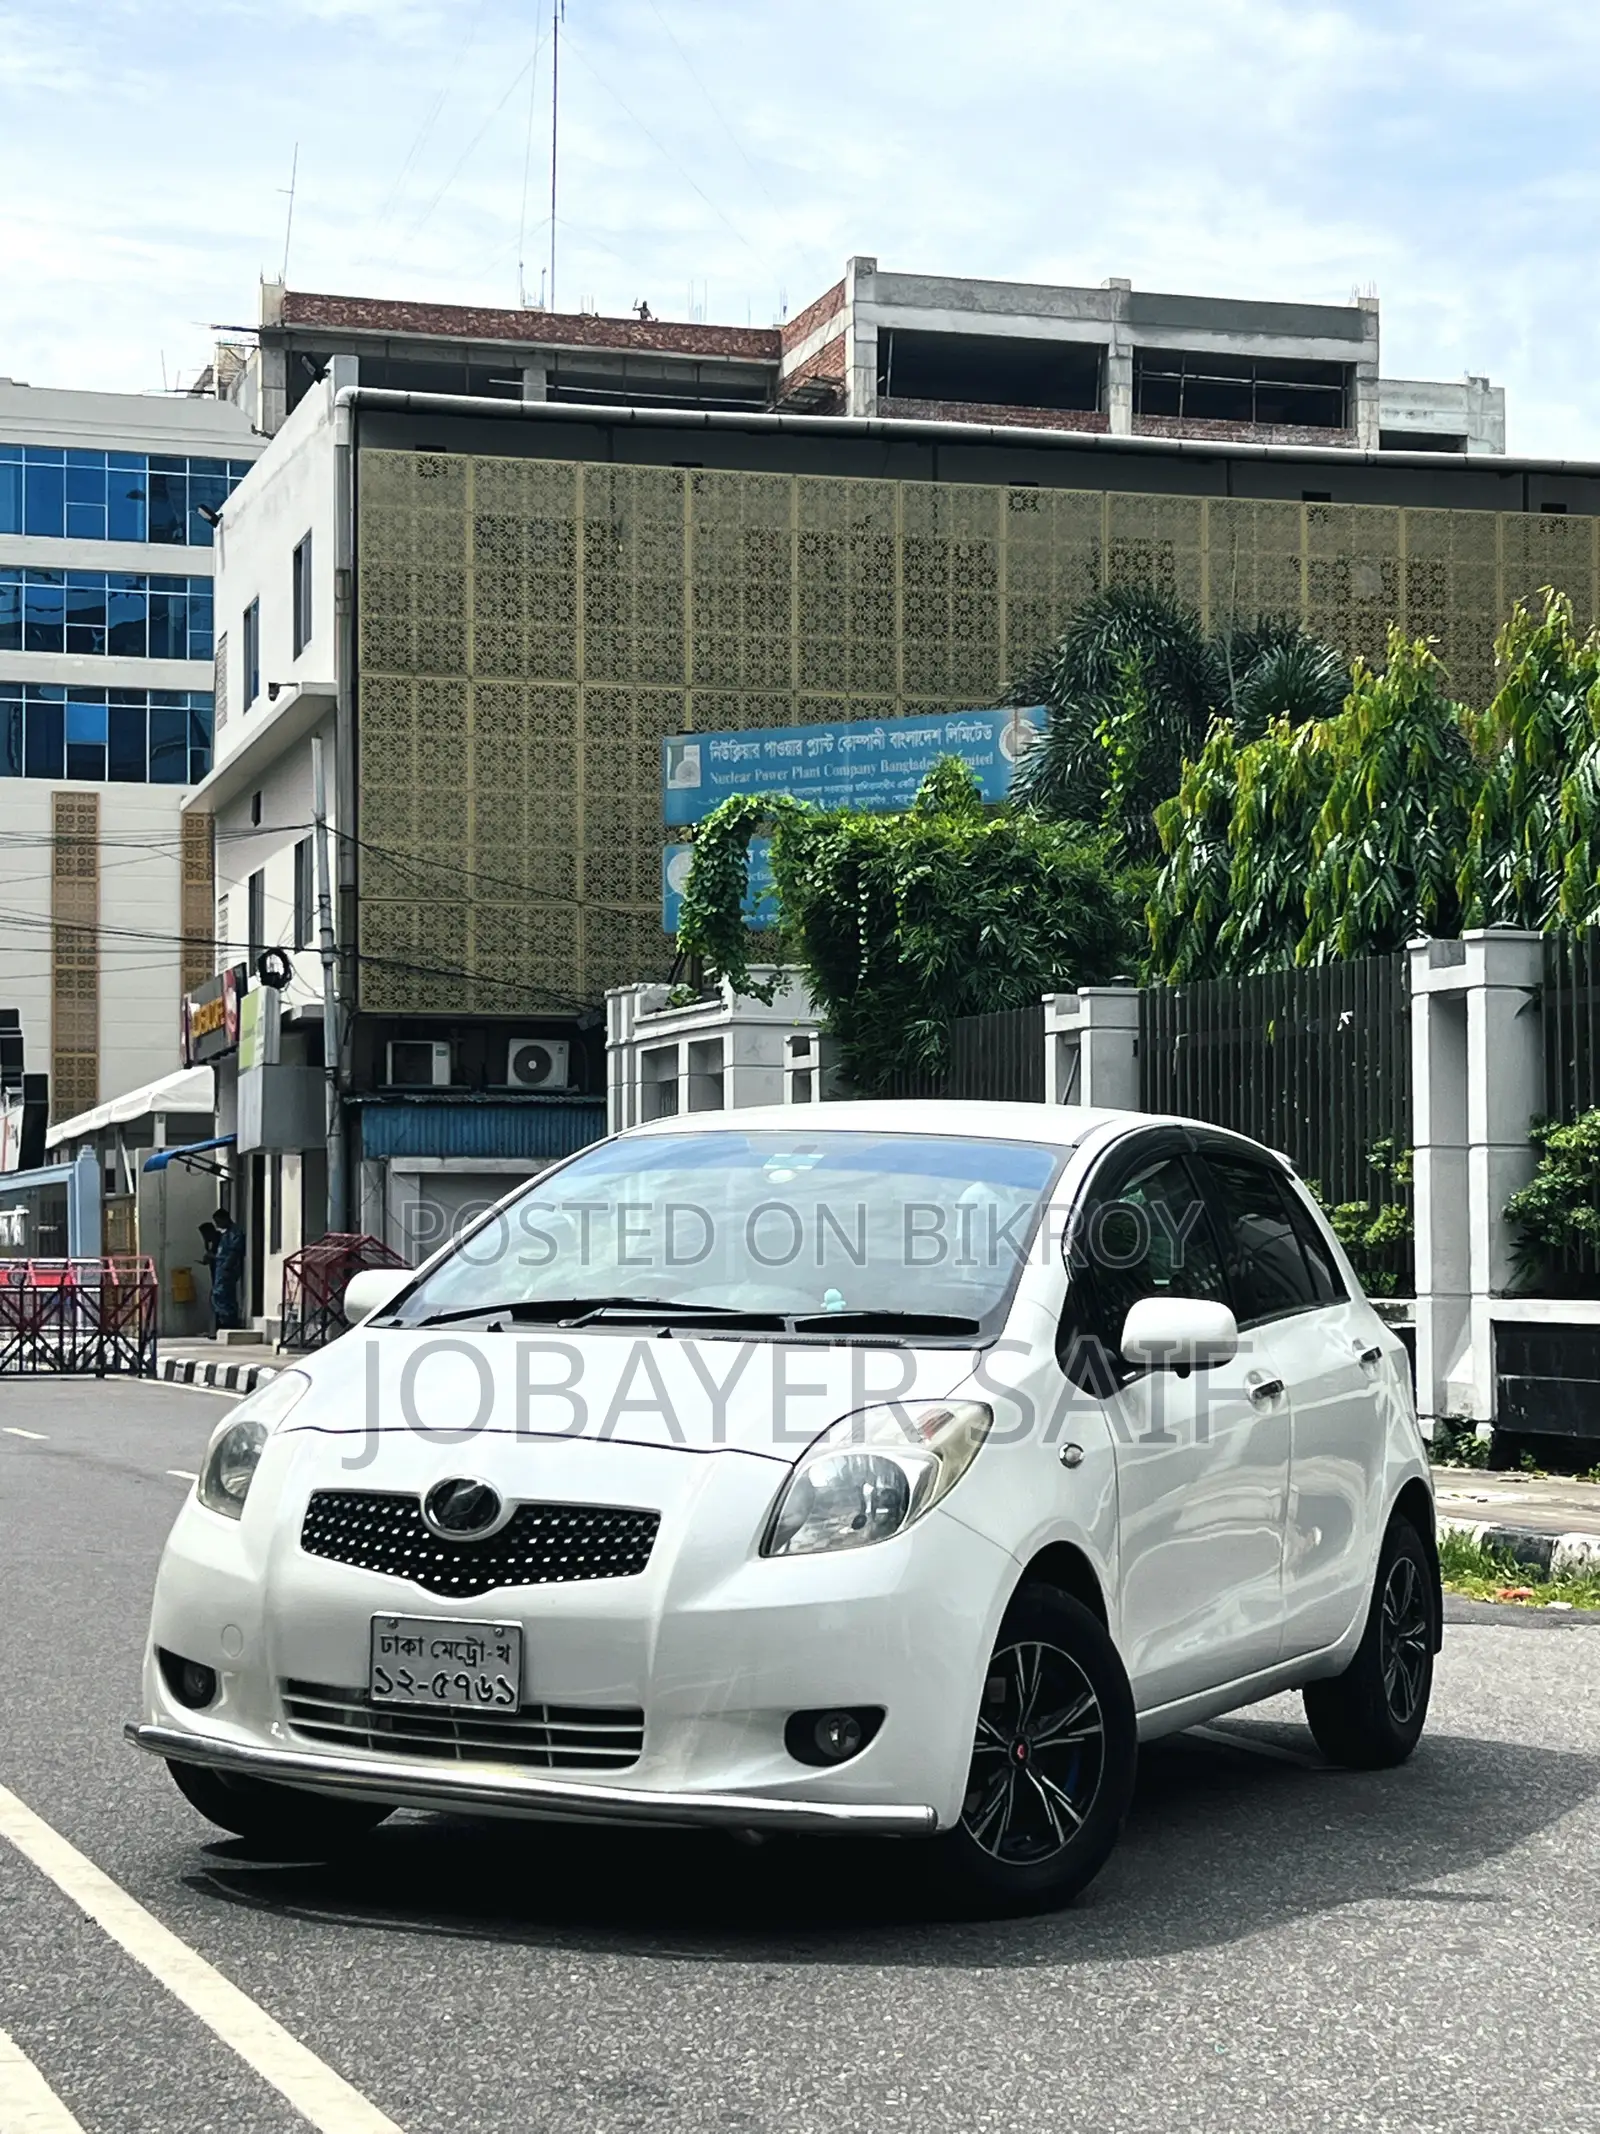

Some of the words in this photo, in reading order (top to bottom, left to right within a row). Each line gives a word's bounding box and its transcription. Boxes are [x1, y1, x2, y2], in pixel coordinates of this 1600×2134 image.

[889, 728, 942, 748] বাংলাদেশ
[945, 720, 994, 744] লিমিটেড
[710, 770, 752, 785] Nuclear
[755, 767, 789, 781] Power
[792, 765, 820, 780] Plant
[824, 761, 876, 779] Company
[380, 1634, 424, 1657] ঢাকা
[374, 1666, 515, 1706] ১২-৫৭৬১
